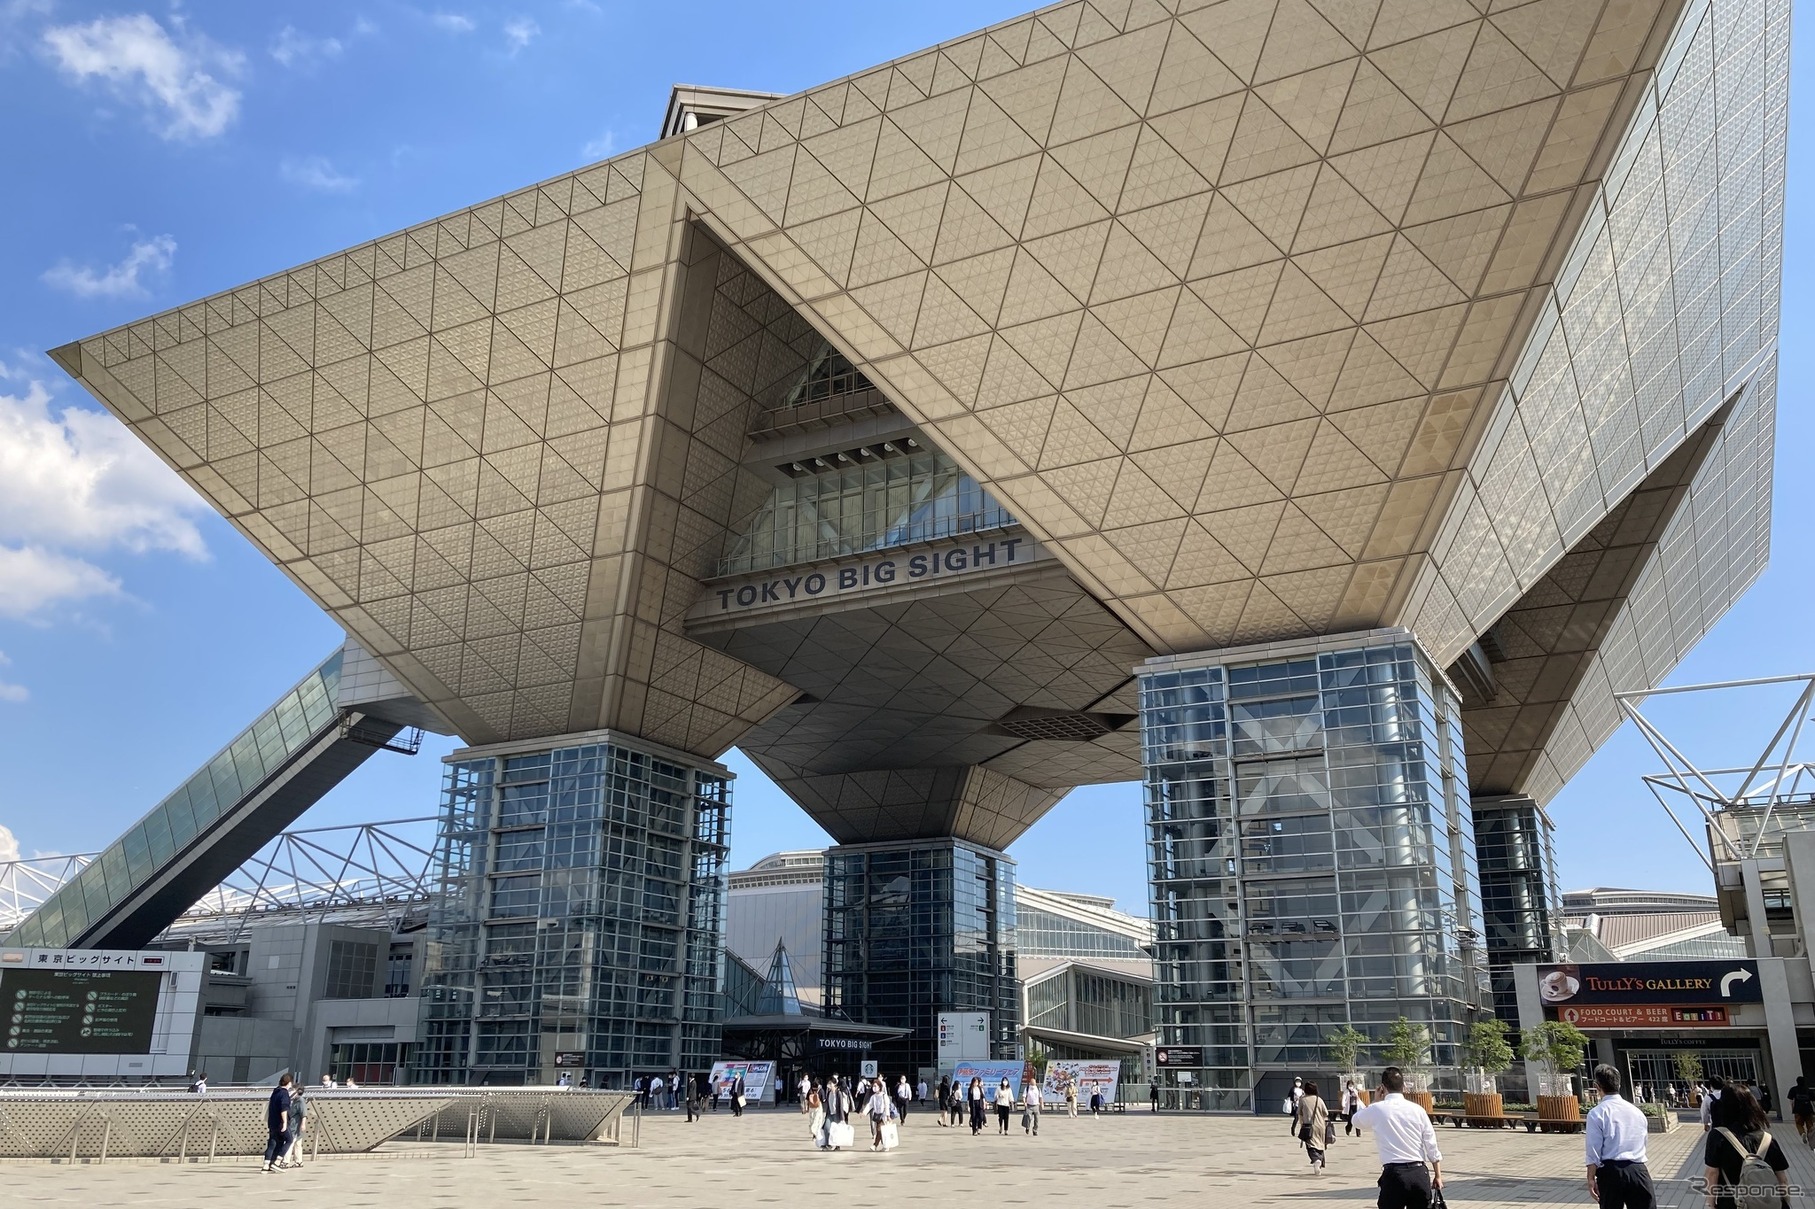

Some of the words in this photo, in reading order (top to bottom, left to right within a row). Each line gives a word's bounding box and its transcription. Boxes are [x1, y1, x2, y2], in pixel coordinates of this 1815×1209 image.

[716, 573, 826, 610] TOKYO
[838, 560, 896, 590] BIG
[908, 538, 1023, 578] SIGHT
[37, 954, 135, 965] 東京ビッグサイト
[1646, 978, 1713, 990] GALLERY
[1605, 1008, 1633, 1016] COURT
[1636, 1008, 1643, 1016] &
[1646, 1008, 1668, 1016] BEER
[819, 1039, 846, 1048] TOKYO
[847, 1040, 858, 1049] BIG
[858, 1041, 873, 1049] SIGHT
